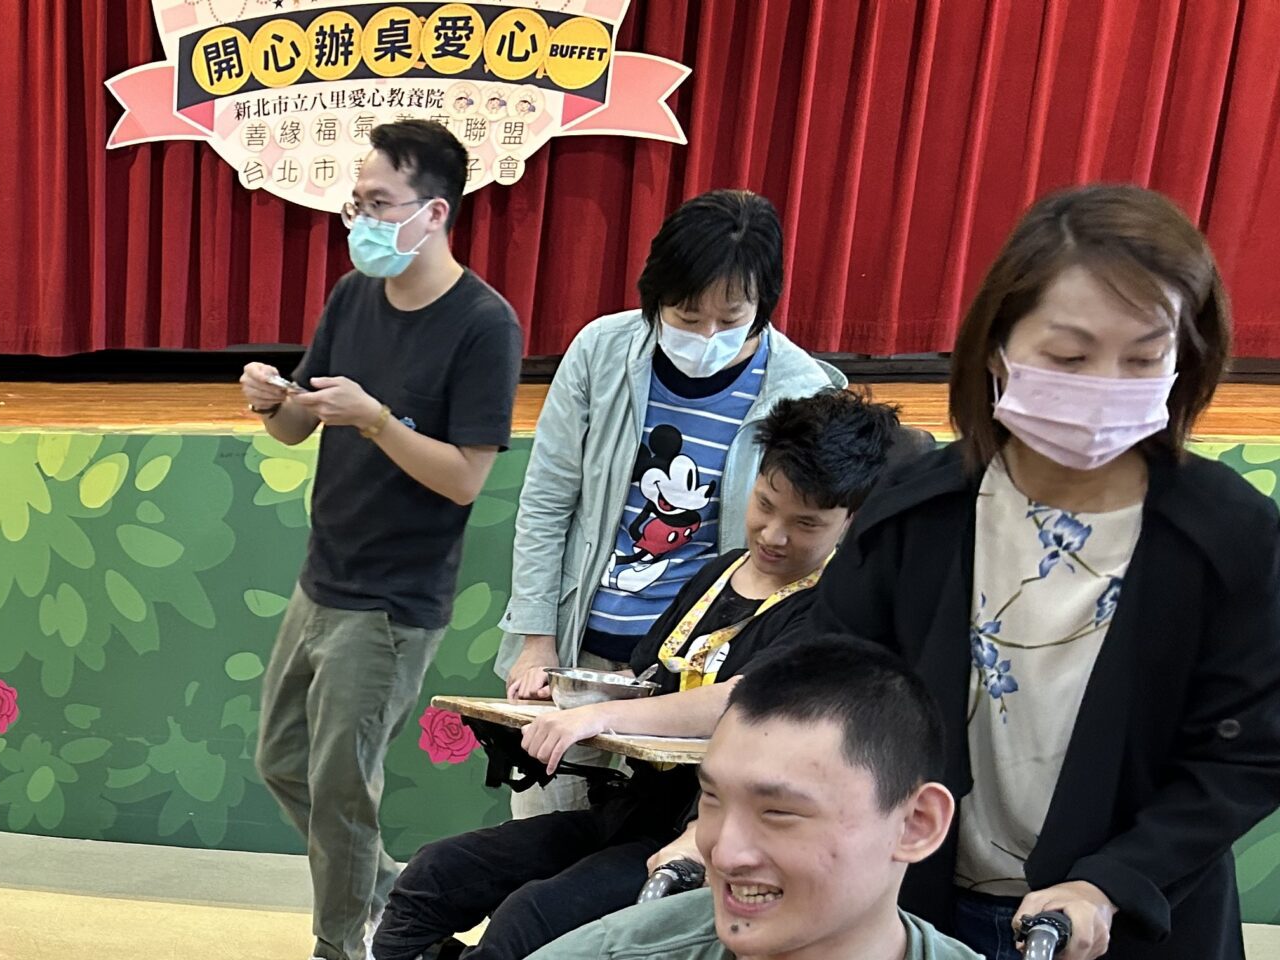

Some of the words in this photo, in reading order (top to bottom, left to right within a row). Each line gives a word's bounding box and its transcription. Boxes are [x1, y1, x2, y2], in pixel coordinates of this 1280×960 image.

[203, 14, 538, 86] 開心辦桌愛心
[549, 44, 608, 62] BUFFET
[234, 87, 444, 121] 新北市立八里愛心教養院
